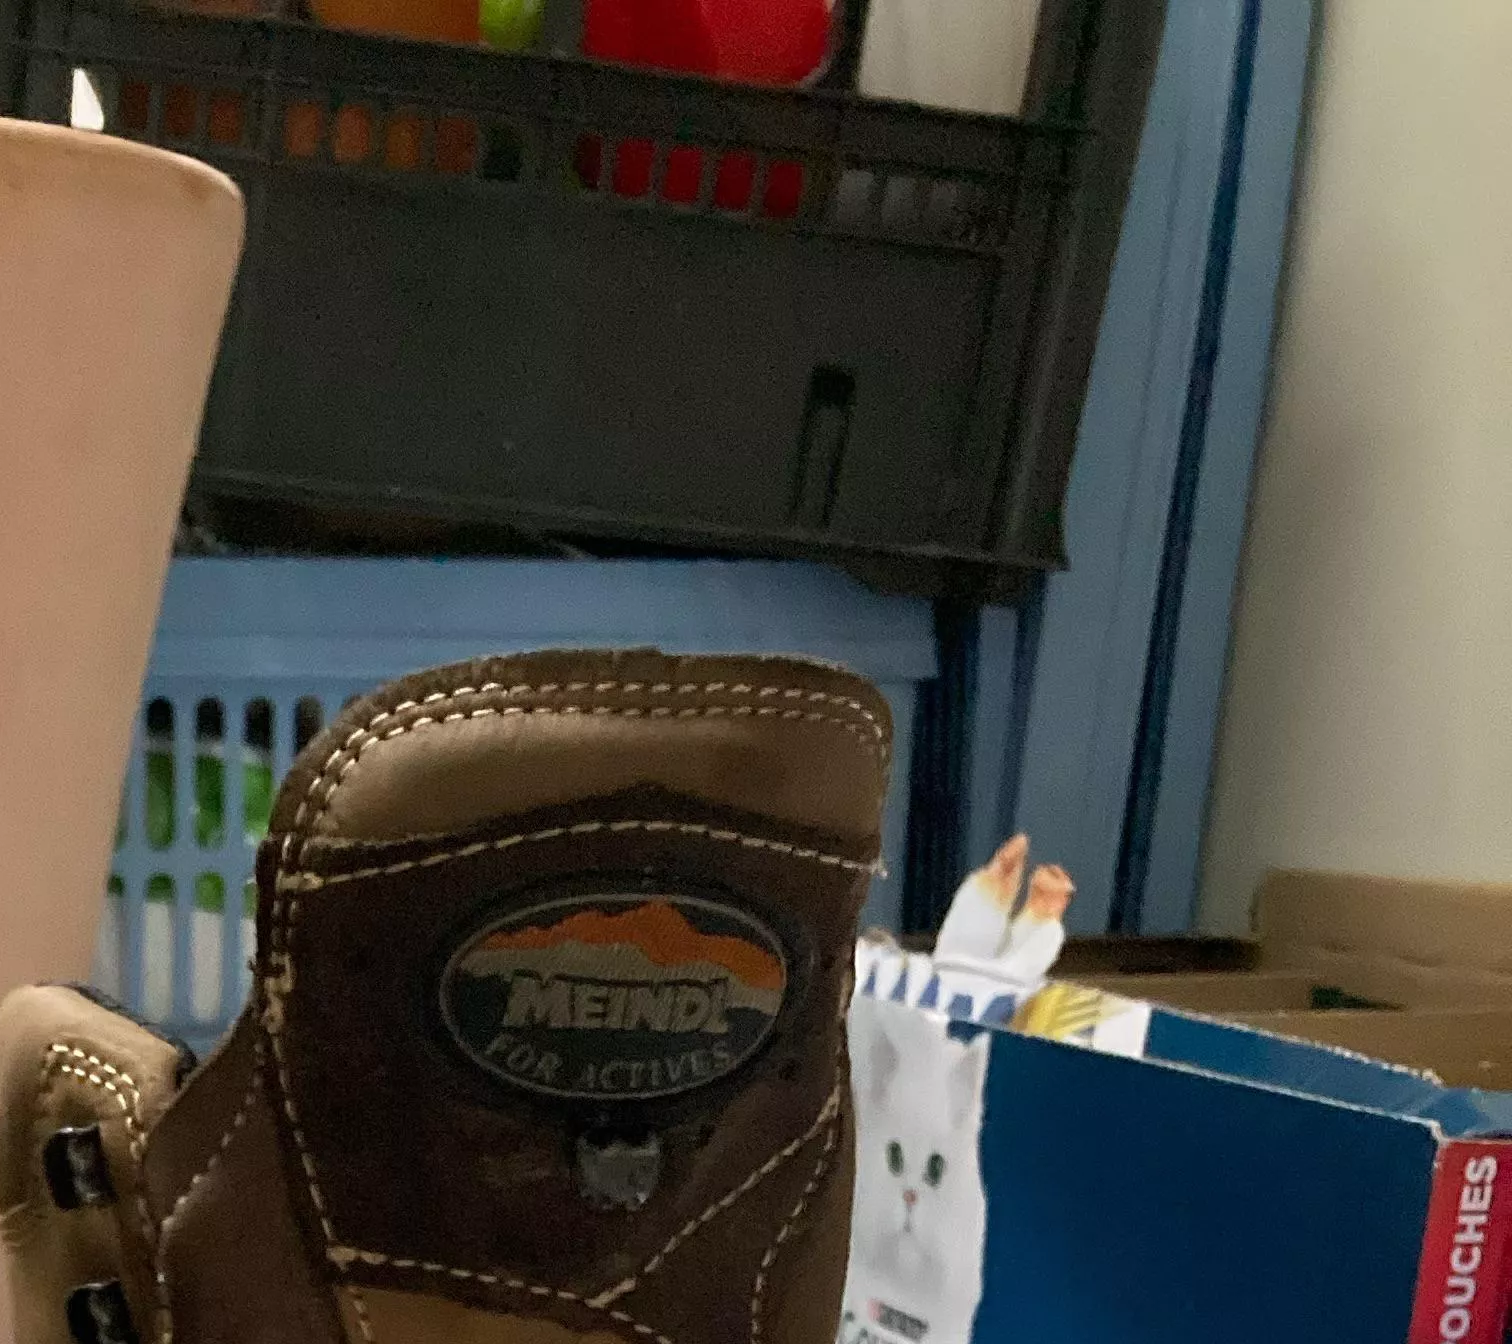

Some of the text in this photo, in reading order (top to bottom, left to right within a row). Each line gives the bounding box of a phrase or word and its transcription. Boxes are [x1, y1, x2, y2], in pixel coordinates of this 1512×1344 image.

[501, 974, 730, 1035] MEINDL
[483, 1033, 733, 1091] FOR ACTIVES
